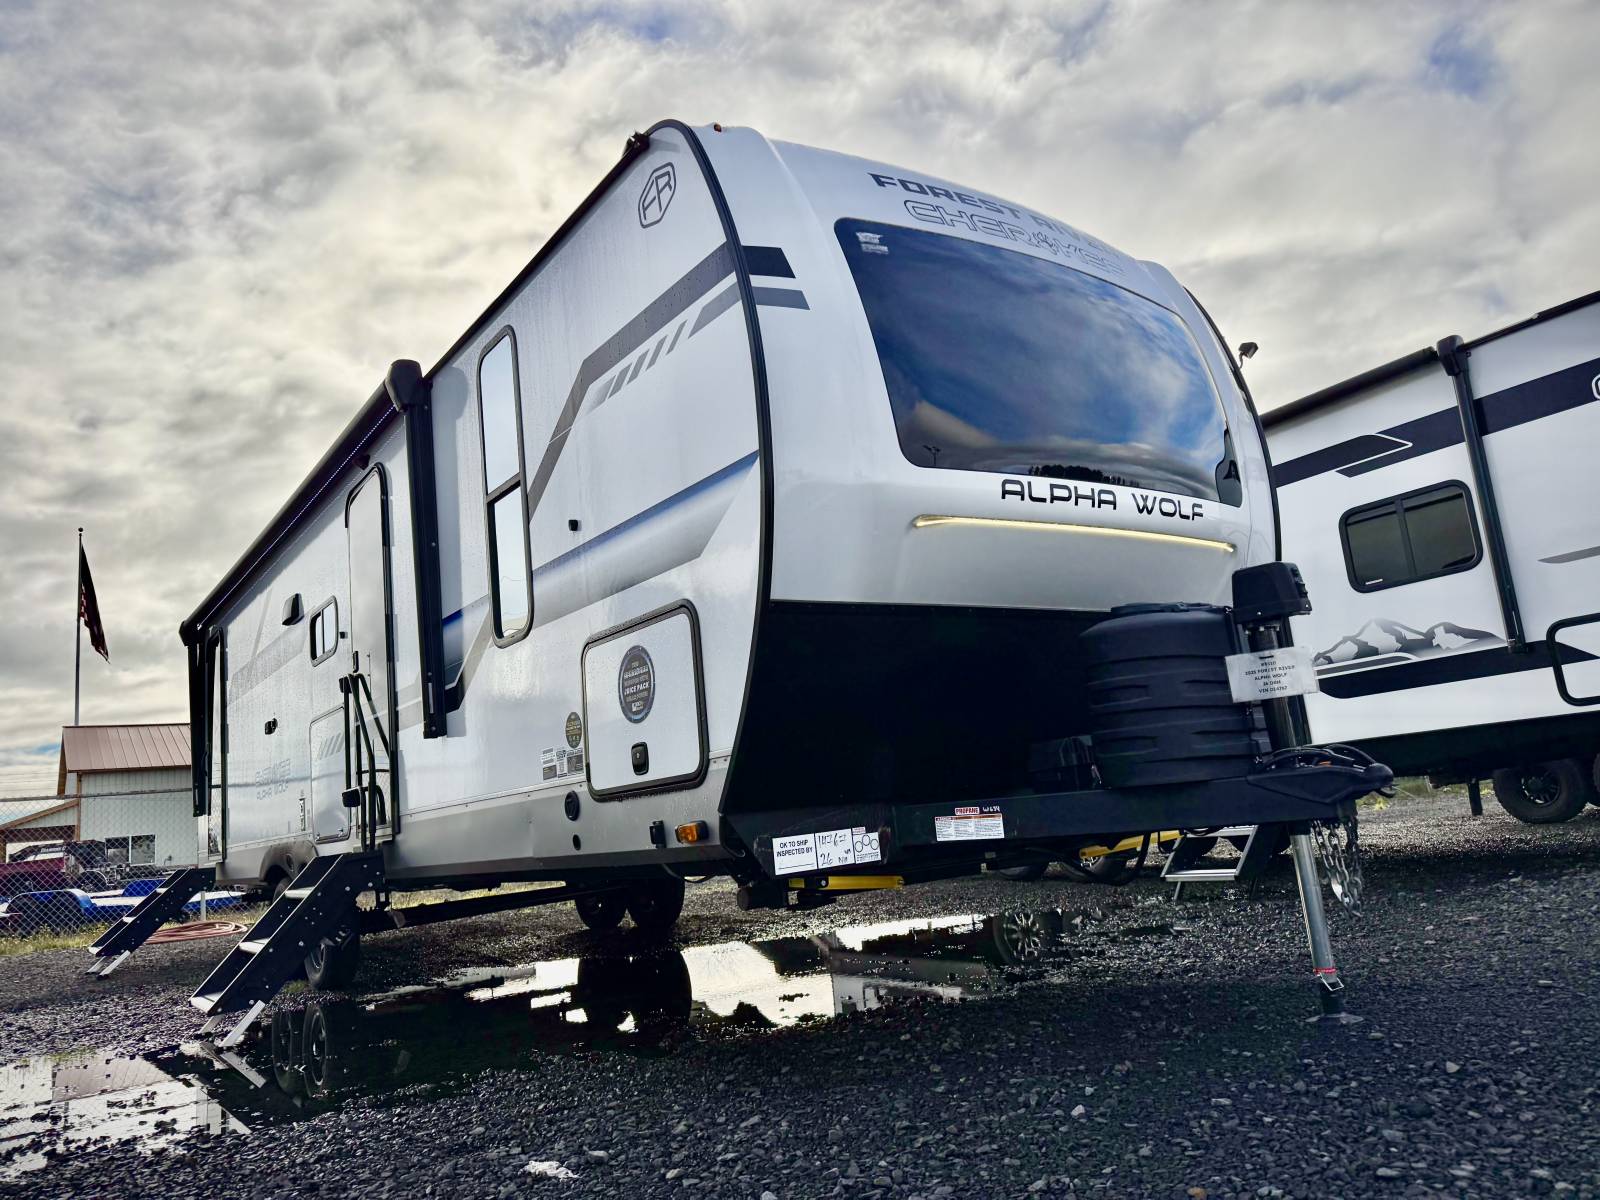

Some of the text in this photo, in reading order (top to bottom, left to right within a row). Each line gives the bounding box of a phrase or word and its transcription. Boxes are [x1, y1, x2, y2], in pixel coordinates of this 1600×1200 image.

[868, 172, 1020, 219] FOREST
[1001, 479, 1204, 521] ALPHA WOLF
[776, 848, 805, 857] INSPECTED
[796, 839, 809, 847] SHIP
